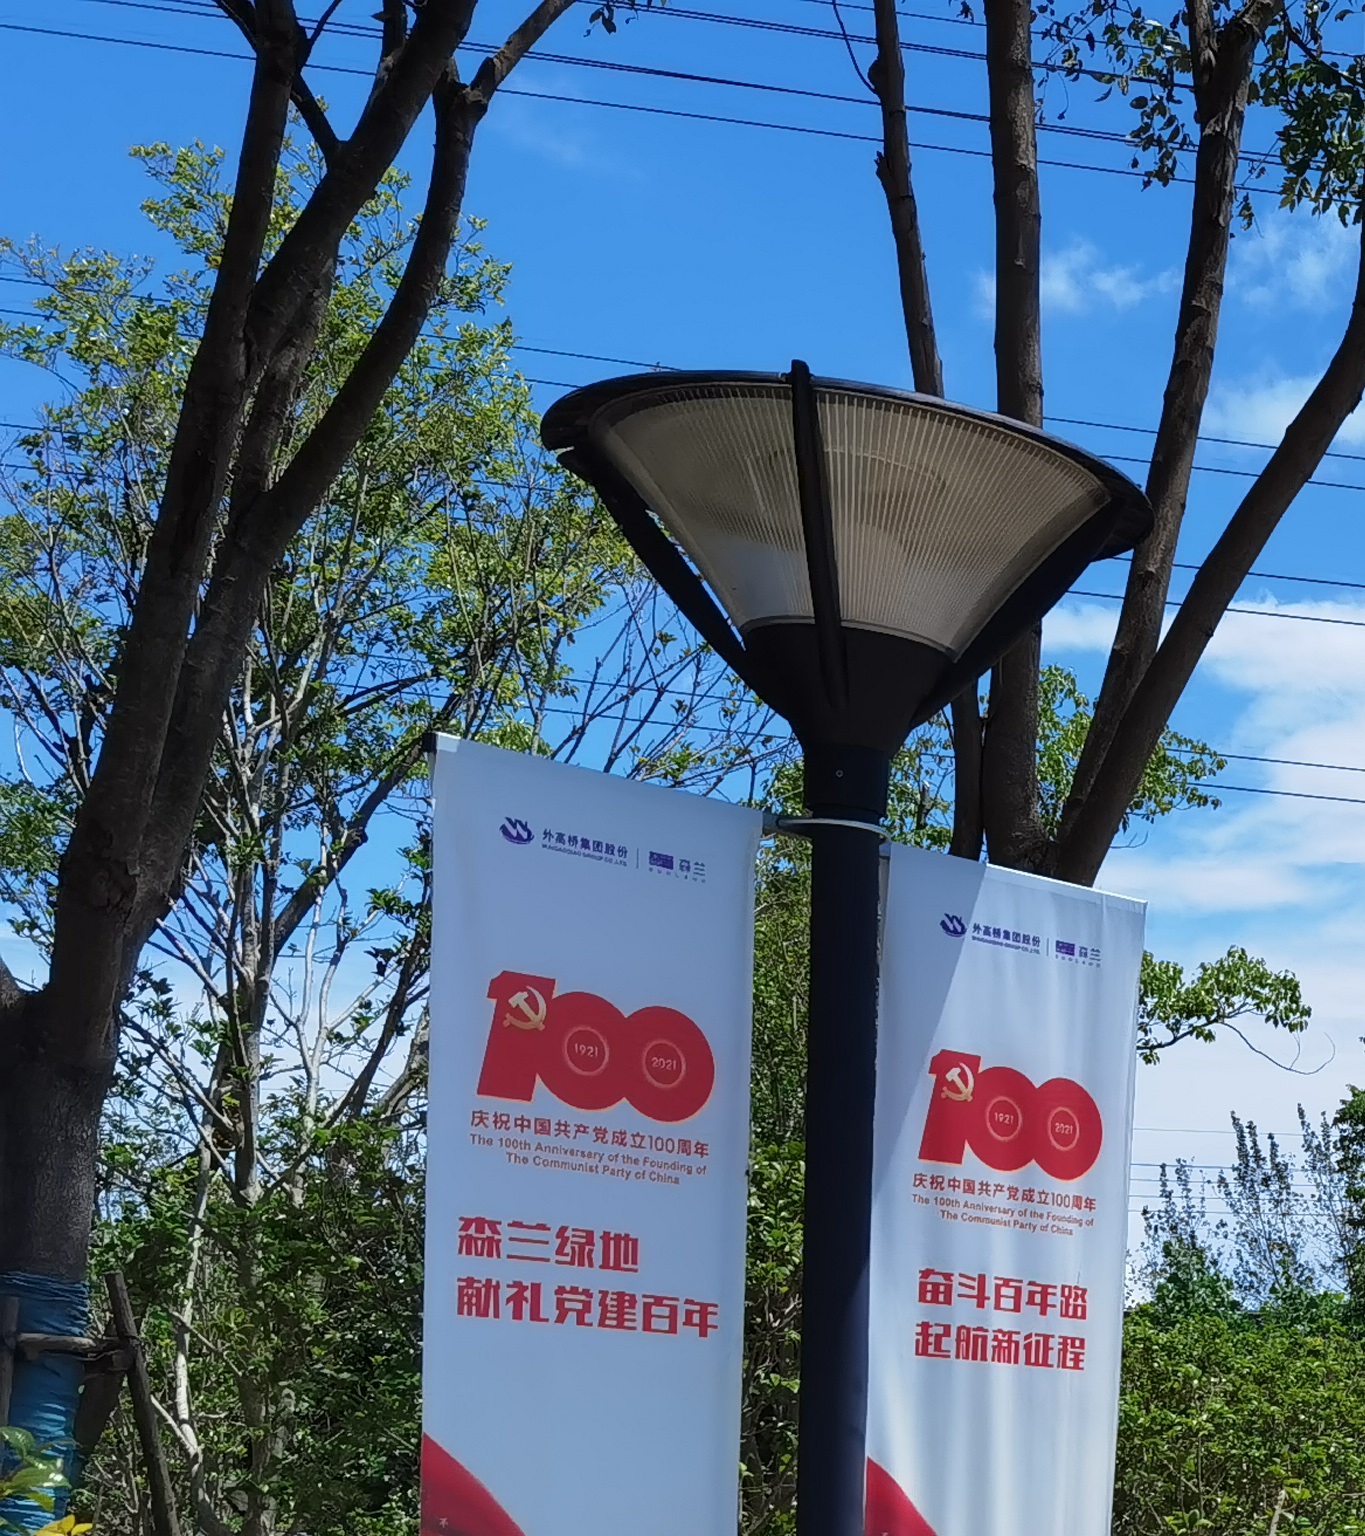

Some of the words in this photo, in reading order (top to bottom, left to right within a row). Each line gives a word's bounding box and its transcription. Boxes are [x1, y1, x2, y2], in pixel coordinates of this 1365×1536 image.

[574, 1043, 598, 1058] 1921
[651, 1056, 677, 1071] 2021
[470, 1109, 709, 1158] 庆祝中国共产党成立100周年
[994, 1112, 1014, 1125] 1921
[1054, 1122, 1073, 1135] 2021
[470, 1133, 493, 1147] The
[498, 1137, 531, 1151] 100th
[534, 1142, 604, 1162] Anniversary
[608, 1152, 619, 1163] of
[621, 1154, 639, 1167] the
[643, 1157, 693, 1175] Founding
[695, 1165, 707, 1176] of
[505, 1152, 528, 1165] The
[532, 1157, 599, 1174] Communist
[602, 1164, 631, 1181] Party
[634, 1169, 646, 1180] of
[649, 1171, 680, 1185] China
[912, 1173, 1097, 1212] 庆祝中国共产党成立100周年
[912, 1193, 930, 1205] The
[933, 1196, 961, 1209] 100th
[963, 1200, 1015, 1218] Anniversary
[1018, 1208, 1028, 1218] of
[1029, 1209, 1044, 1220] the
[1046, 1212, 1083, 1227] Founding
[1085, 1218, 1094, 1227] of
[940, 1209, 958, 1220] The
[960, 1214, 1012, 1228] Communist
[1013, 1220, 1037, 1233] Party
[1040, 1224, 1050, 1232] of
[1050, 1225, 1073, 1236] China
[456, 1216, 640, 1274] 森兰绿地
[456, 1276, 720, 1338] 献礼党建百年
[918, 1267, 1088, 1321] 奋斗百年路
[914, 1321, 1086, 1371] 起航新征程
